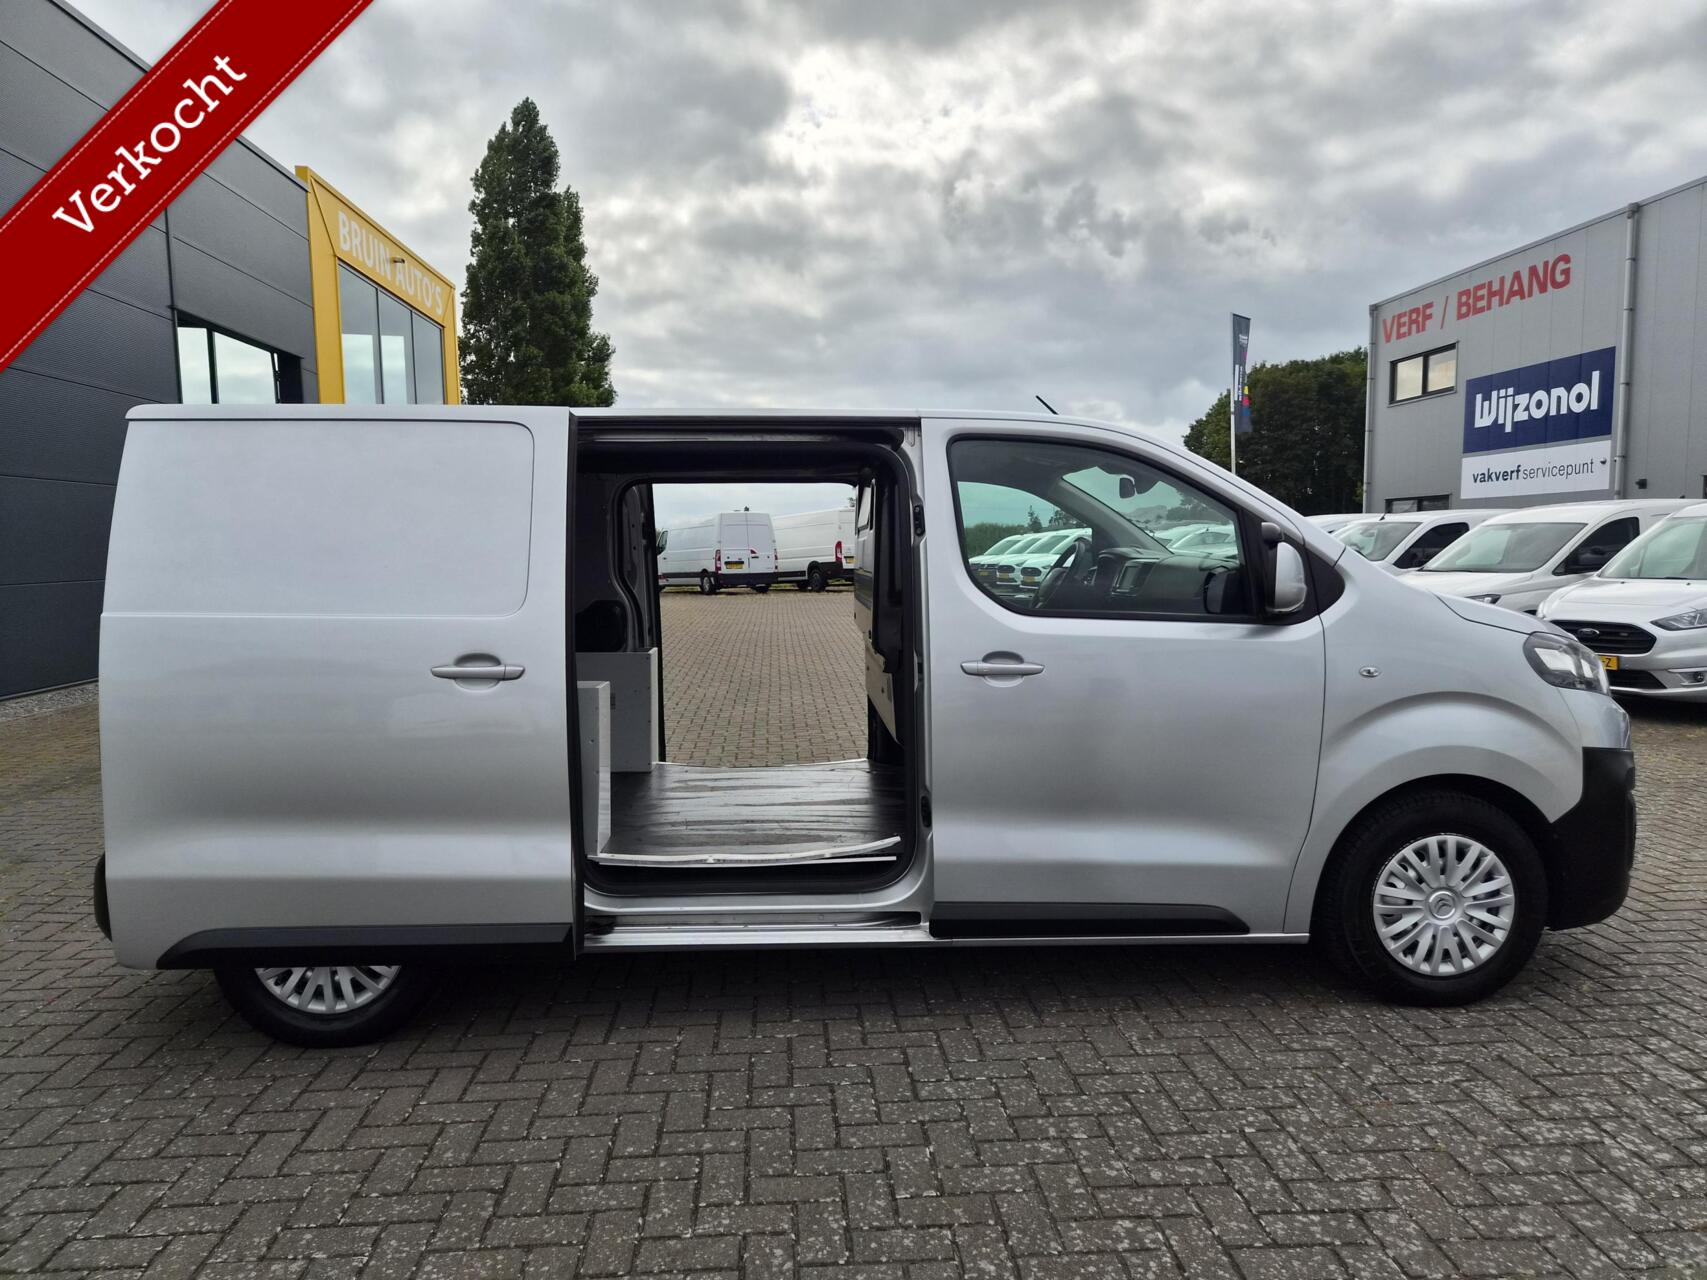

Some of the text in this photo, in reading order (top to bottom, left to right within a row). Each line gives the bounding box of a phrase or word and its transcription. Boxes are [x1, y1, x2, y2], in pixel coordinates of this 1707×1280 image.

[338, 210, 443, 316] BRUIN AUTO'S
[1382, 253, 1571, 344] VERF / BEHANG
[1474, 370, 1600, 433] Wijzonol
[1472, 458, 1594, 484] vakverf servicepunt
